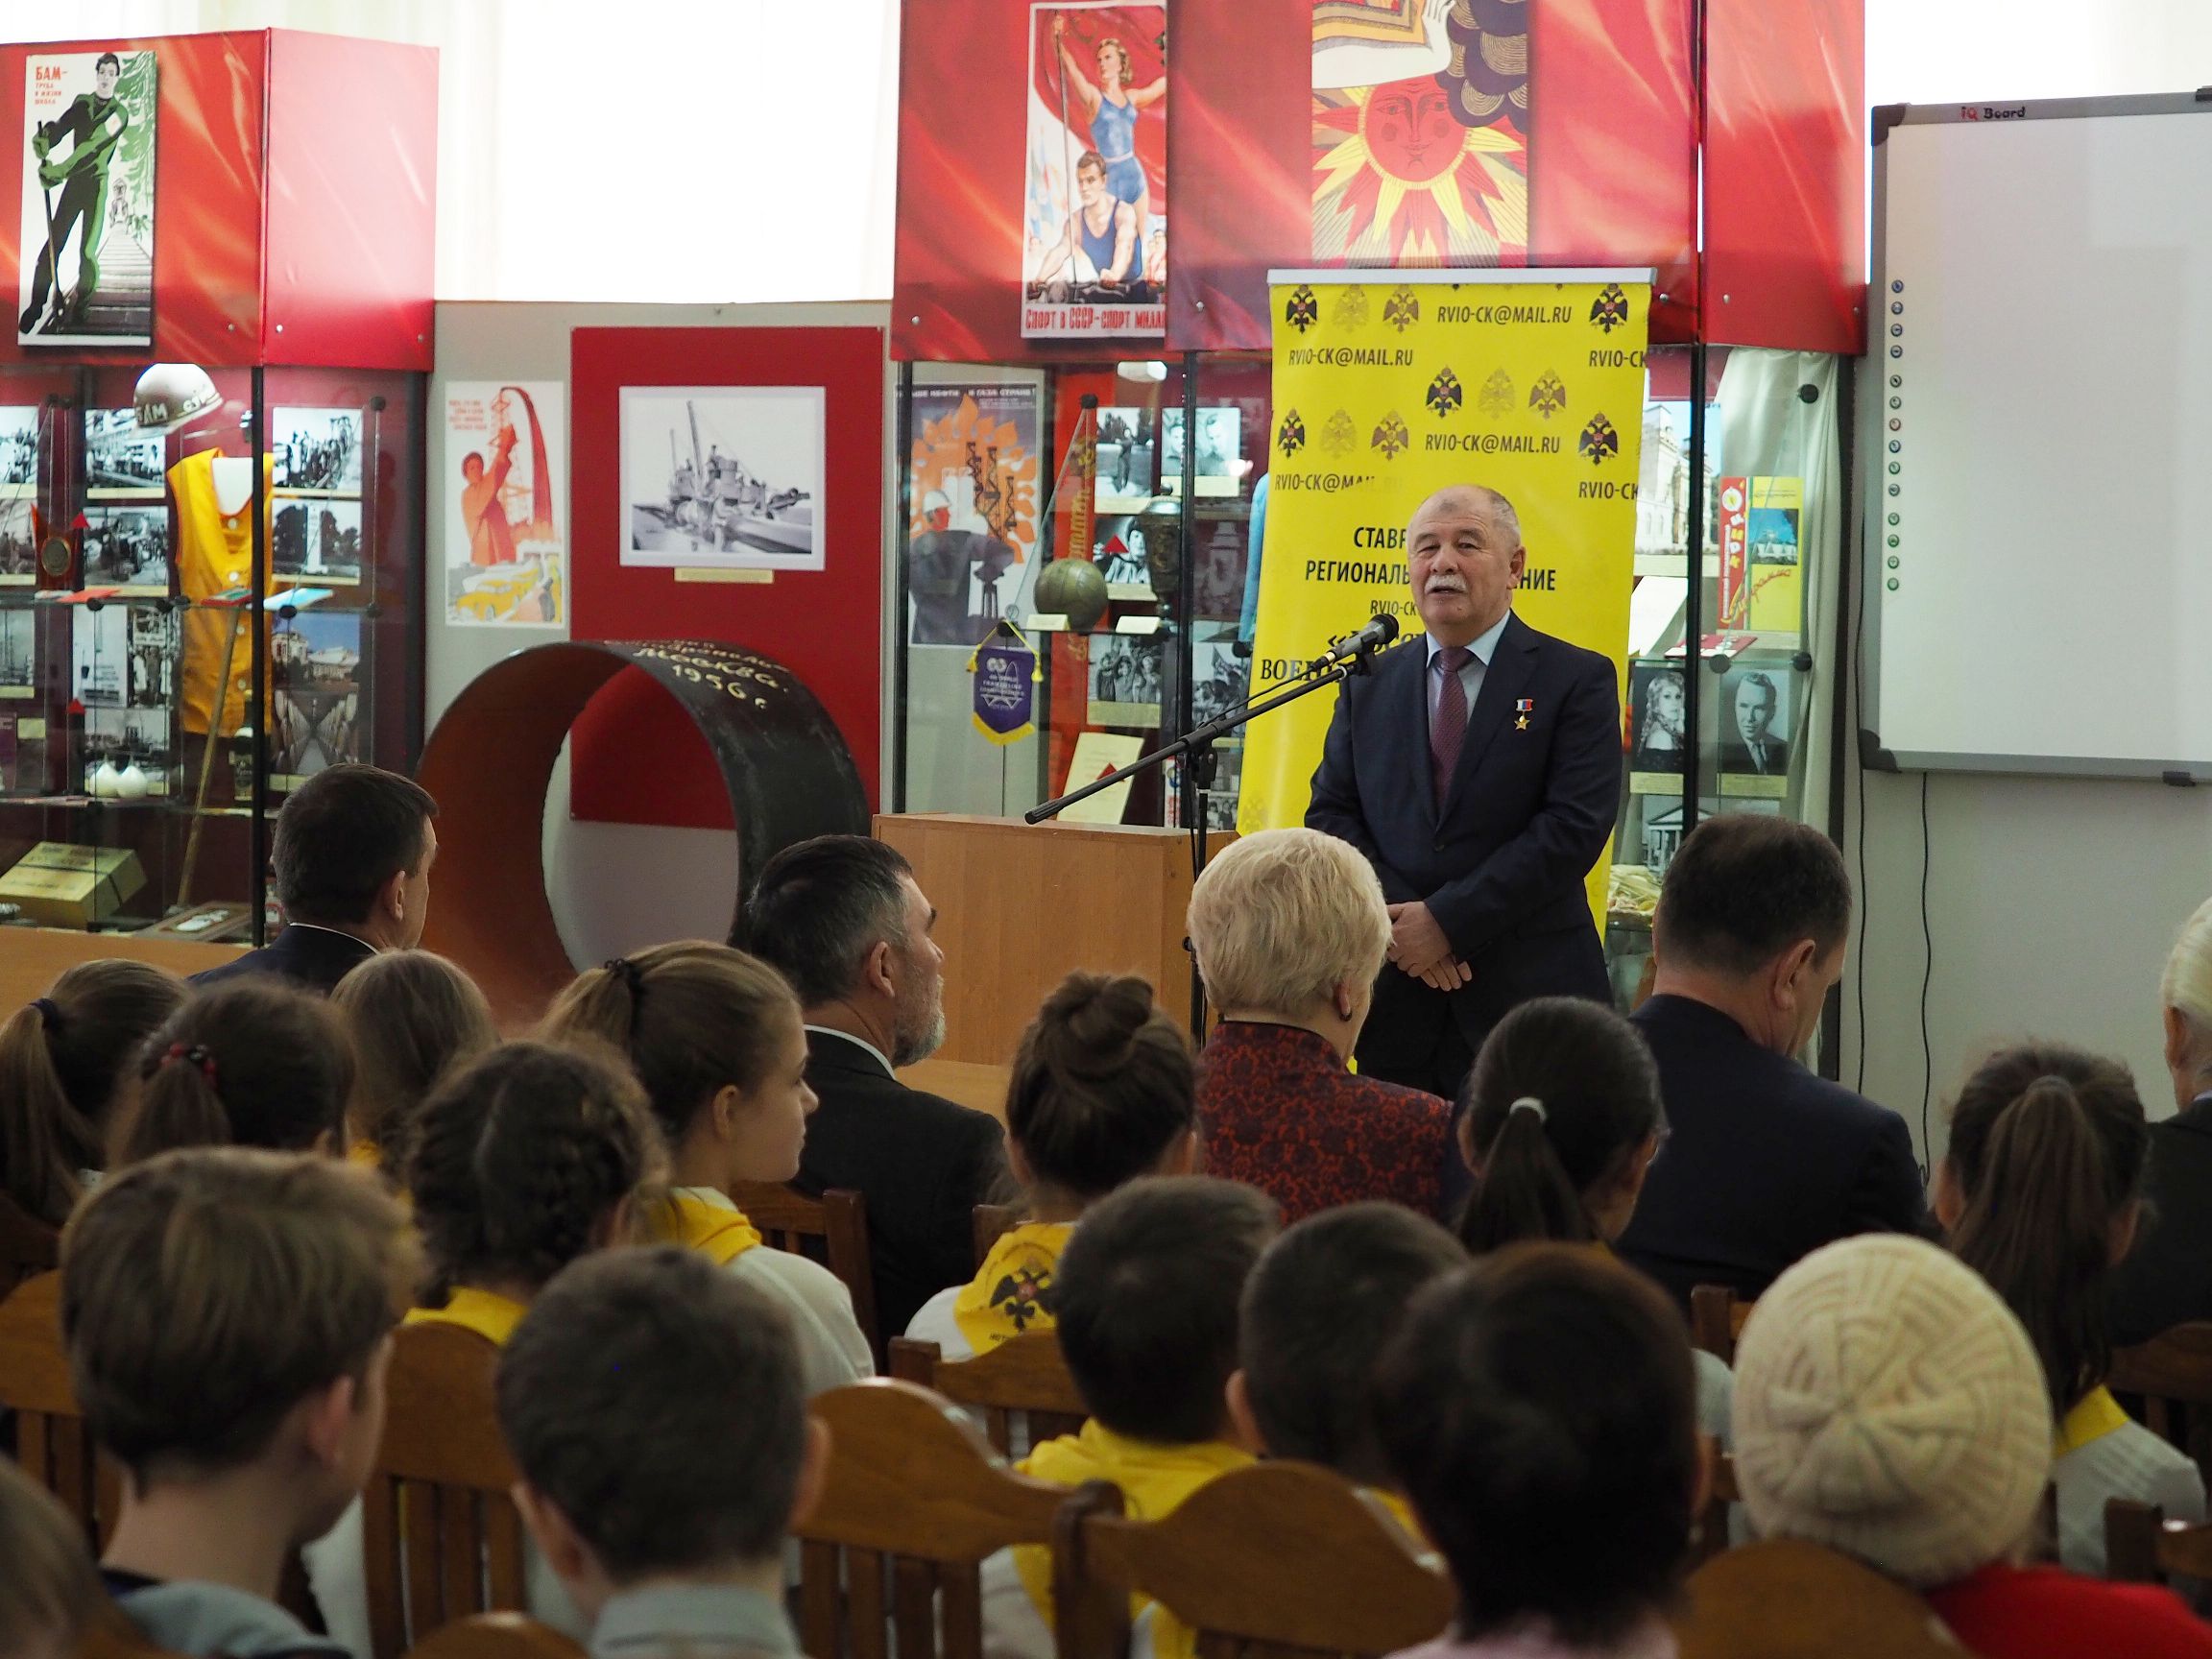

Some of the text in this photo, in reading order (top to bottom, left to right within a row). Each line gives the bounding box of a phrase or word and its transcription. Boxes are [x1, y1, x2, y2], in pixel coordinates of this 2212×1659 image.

[1984, 106, 2026, 119] Board
[1437, 305, 1572, 325] RVIO-CK@MAIL.RU
[1288, 348, 1413, 367] RVIO-CK@MAIL.RU
[1426, 434, 1560, 454] RVIO-CK@MAIL.RU
[1305, 560, 1410, 585] РЕГИОНАЛЬ
